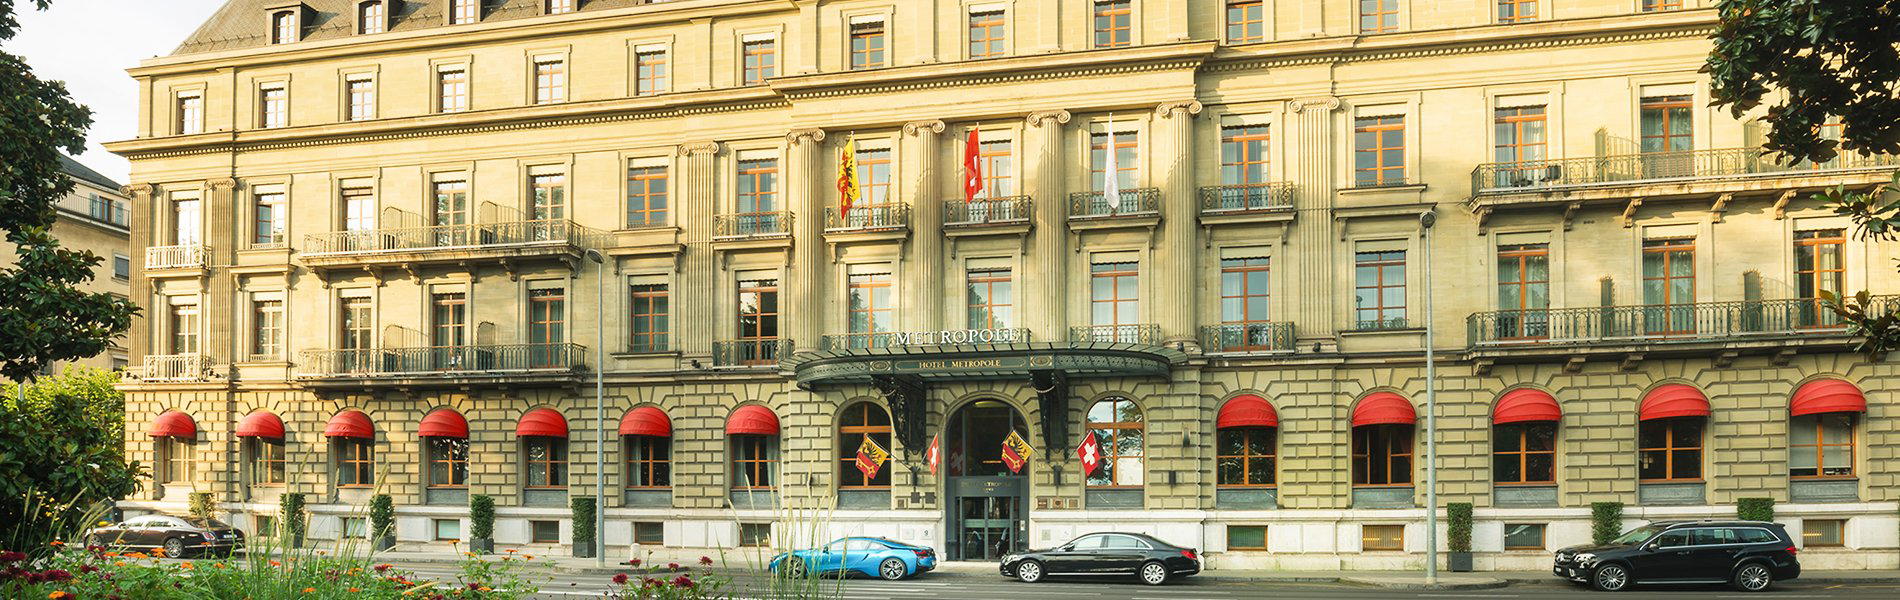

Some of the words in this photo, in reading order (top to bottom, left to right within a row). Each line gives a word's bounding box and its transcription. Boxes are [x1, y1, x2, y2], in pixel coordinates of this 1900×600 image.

[896, 328, 1020, 345] METROPOLE
[920, 361, 946, 369] HOTEL
[951, 360, 1001, 368] METROPOLE
